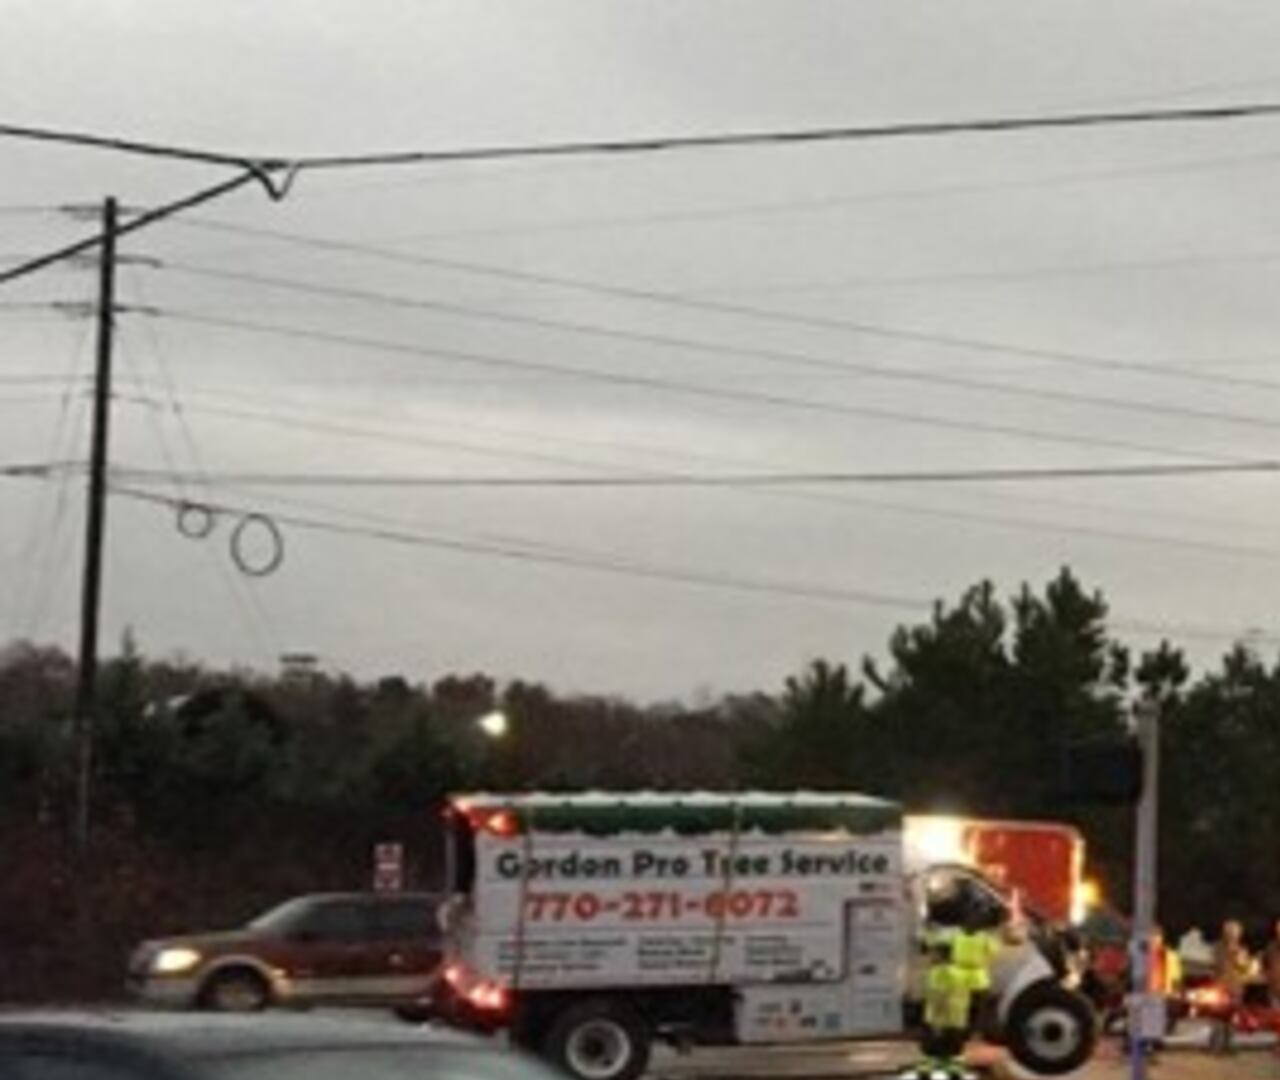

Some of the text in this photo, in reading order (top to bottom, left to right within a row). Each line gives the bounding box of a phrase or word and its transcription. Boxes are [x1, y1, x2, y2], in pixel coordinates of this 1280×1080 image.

[496, 850, 620, 879] Gordon
[632, 851, 689, 877] Pro
[780, 848, 889, 875] Service
